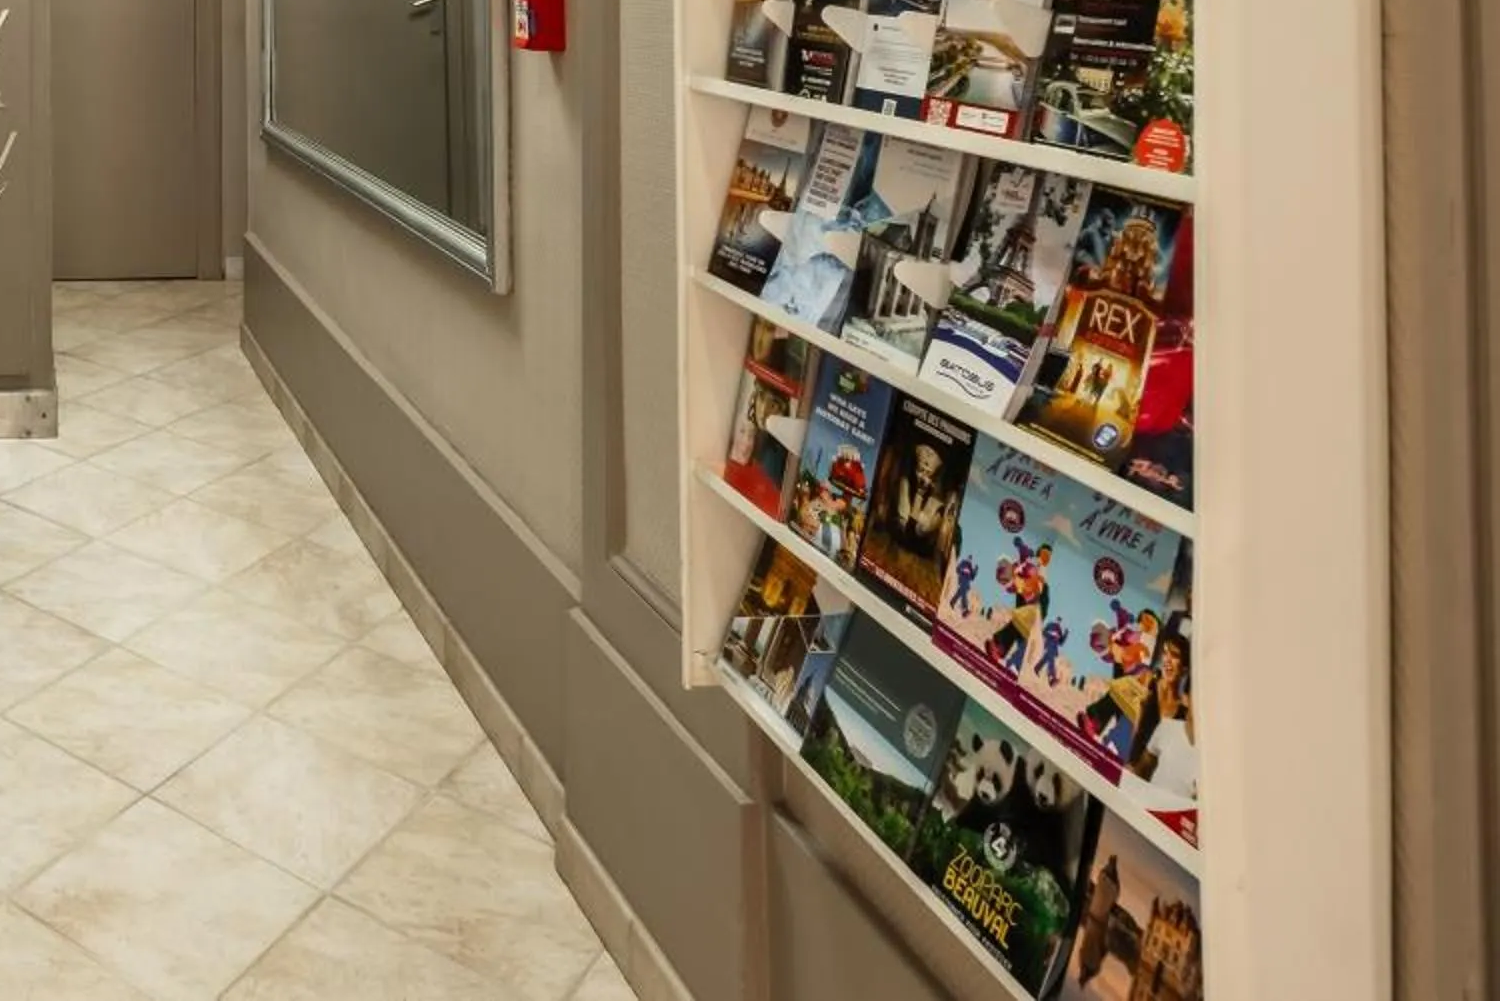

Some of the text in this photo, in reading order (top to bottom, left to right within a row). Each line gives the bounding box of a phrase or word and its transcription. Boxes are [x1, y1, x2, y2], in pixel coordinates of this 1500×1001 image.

[1089, 297, 1142, 344] REX
[1097, 518, 1144, 550] VIVRE
[991, 836, 1008, 858] 4
[943, 865, 1009, 950] BEAUVAL
[949, 842, 1024, 927] ZOOPARC
